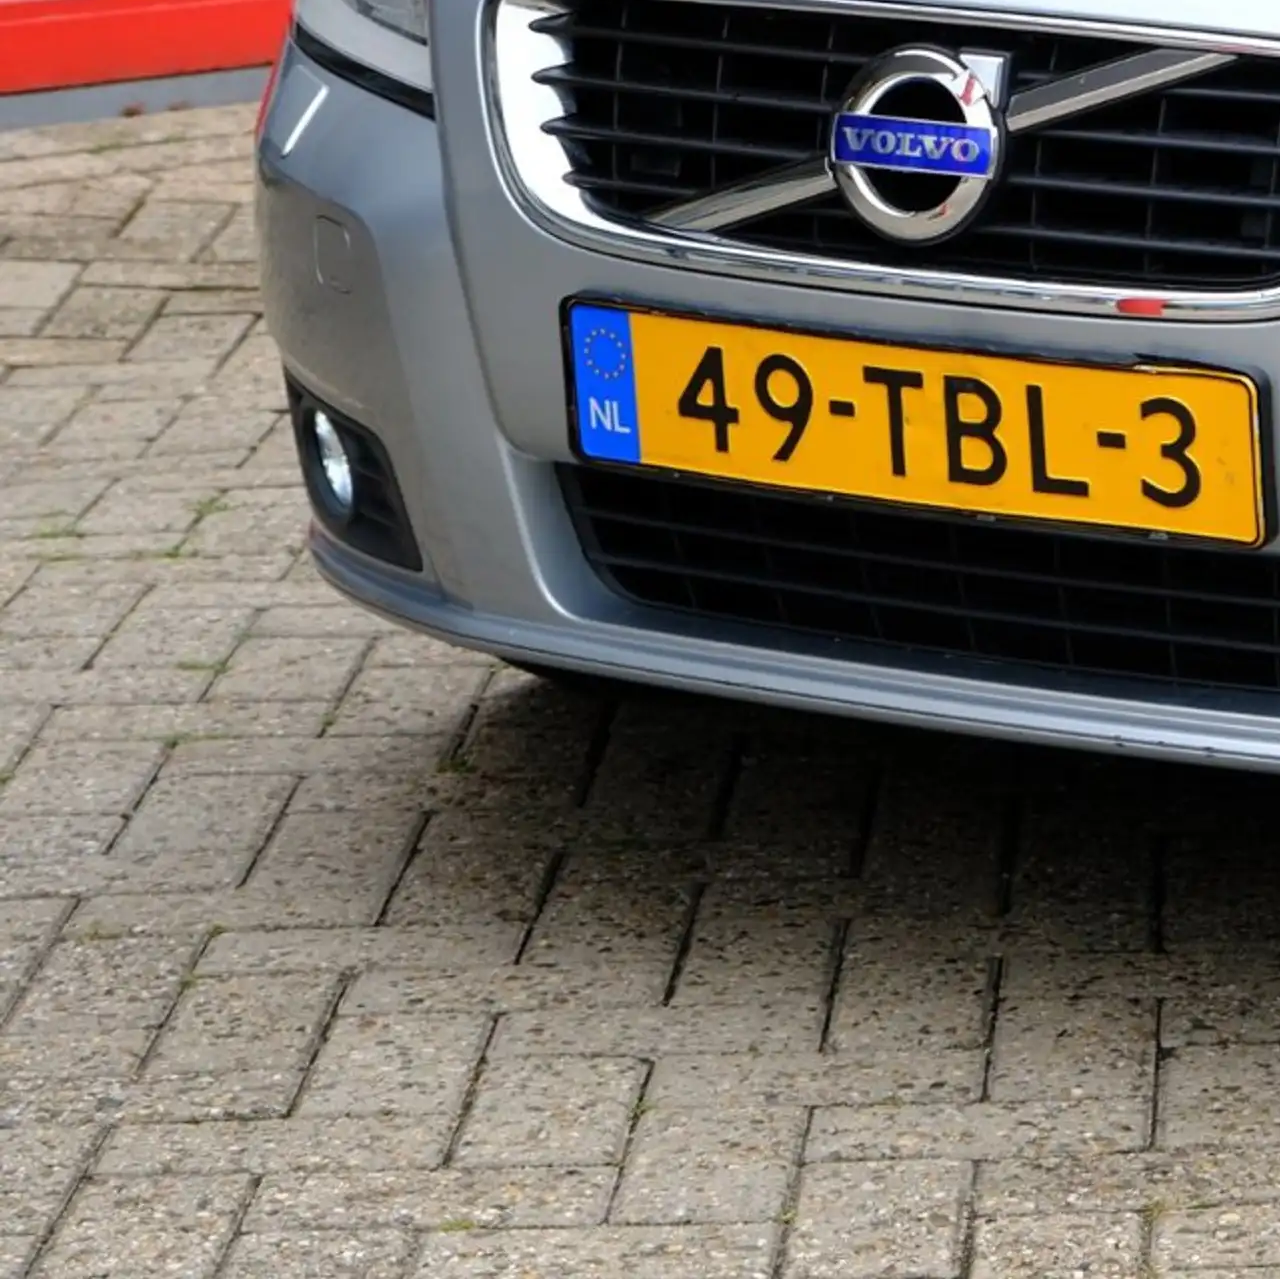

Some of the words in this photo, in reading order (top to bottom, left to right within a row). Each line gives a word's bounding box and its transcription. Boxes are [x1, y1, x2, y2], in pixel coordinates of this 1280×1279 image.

[842, 126, 980, 162] VOLVO
[588, 396, 632, 435] NL
[677, 346, 1202, 510] 49-TBL-3
